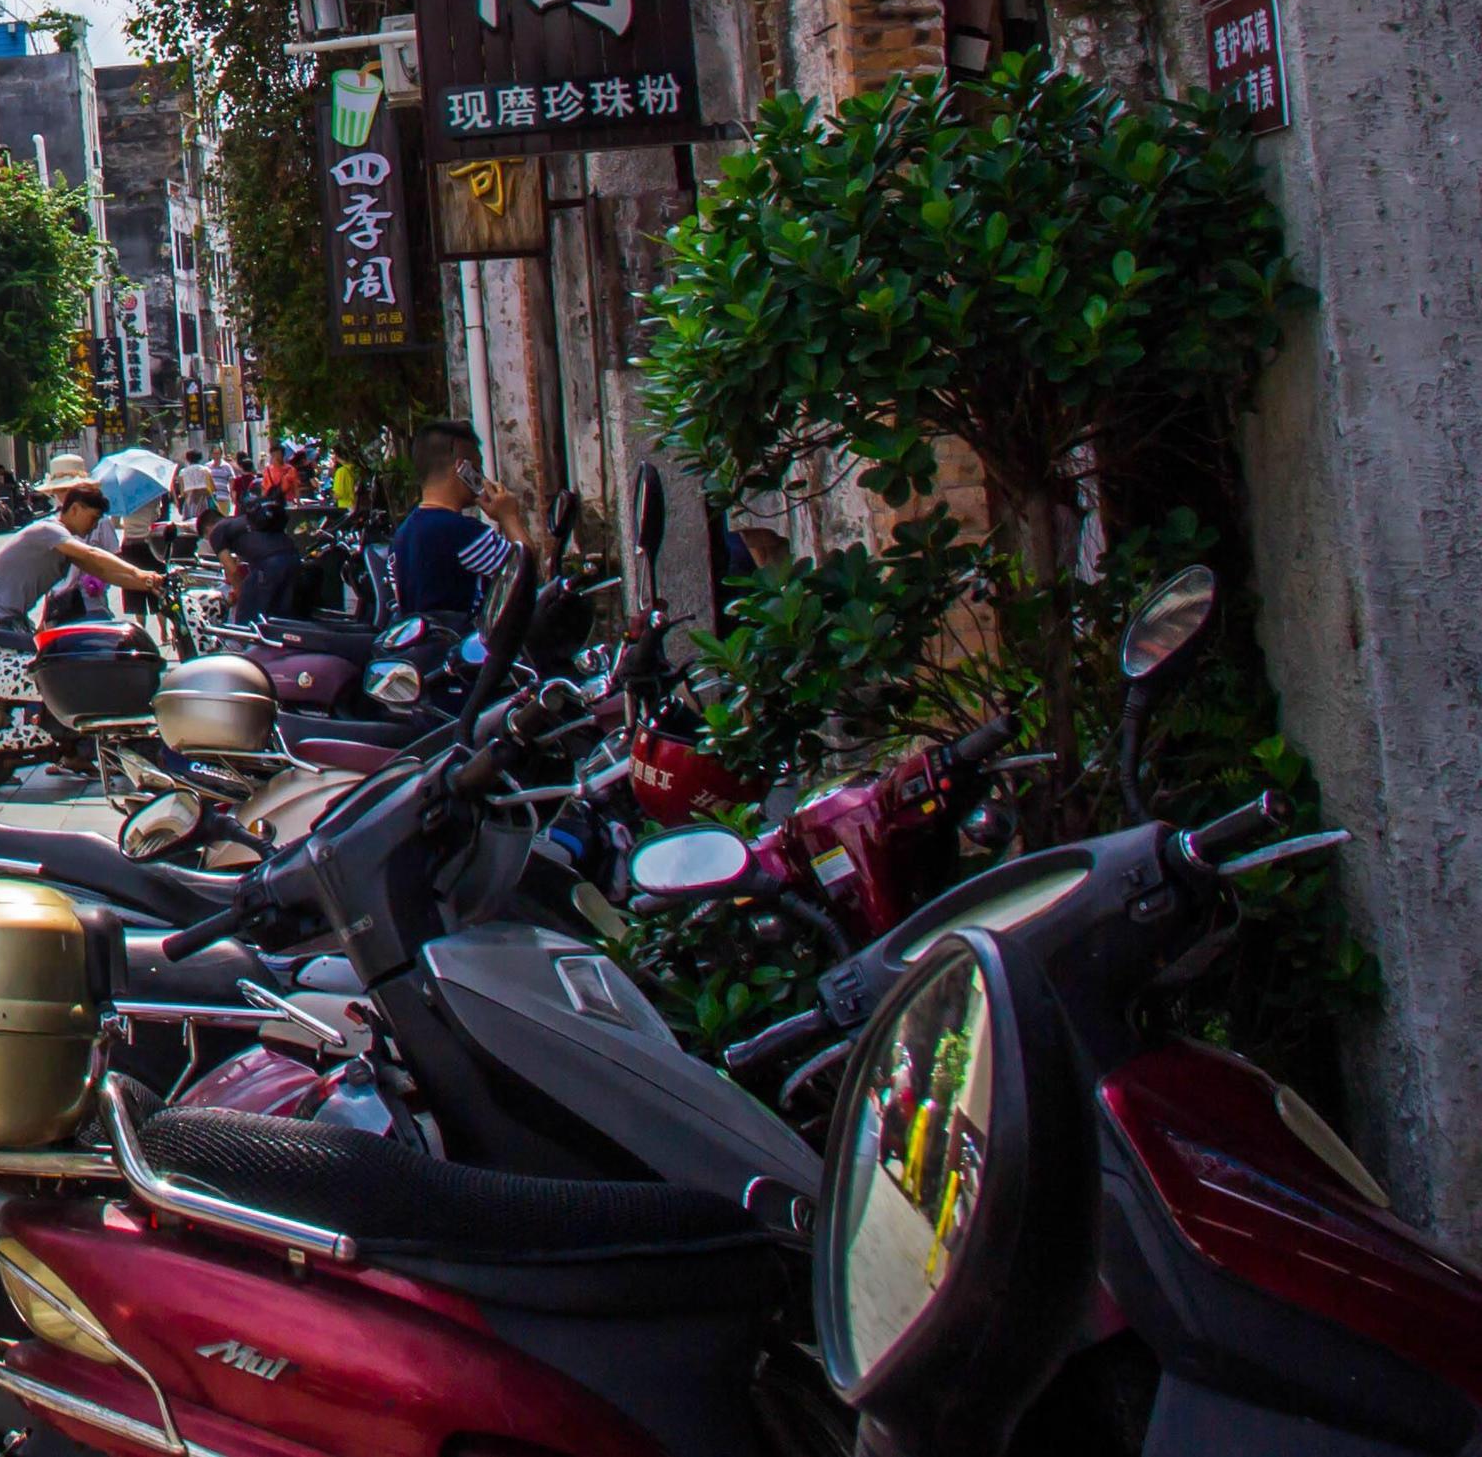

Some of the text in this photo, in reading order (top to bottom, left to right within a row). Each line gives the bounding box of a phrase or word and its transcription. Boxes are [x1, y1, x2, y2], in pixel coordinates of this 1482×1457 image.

[1213, 7, 1271, 70] 爱护环境
[447, 71, 682, 130] 现磨珍珠粉
